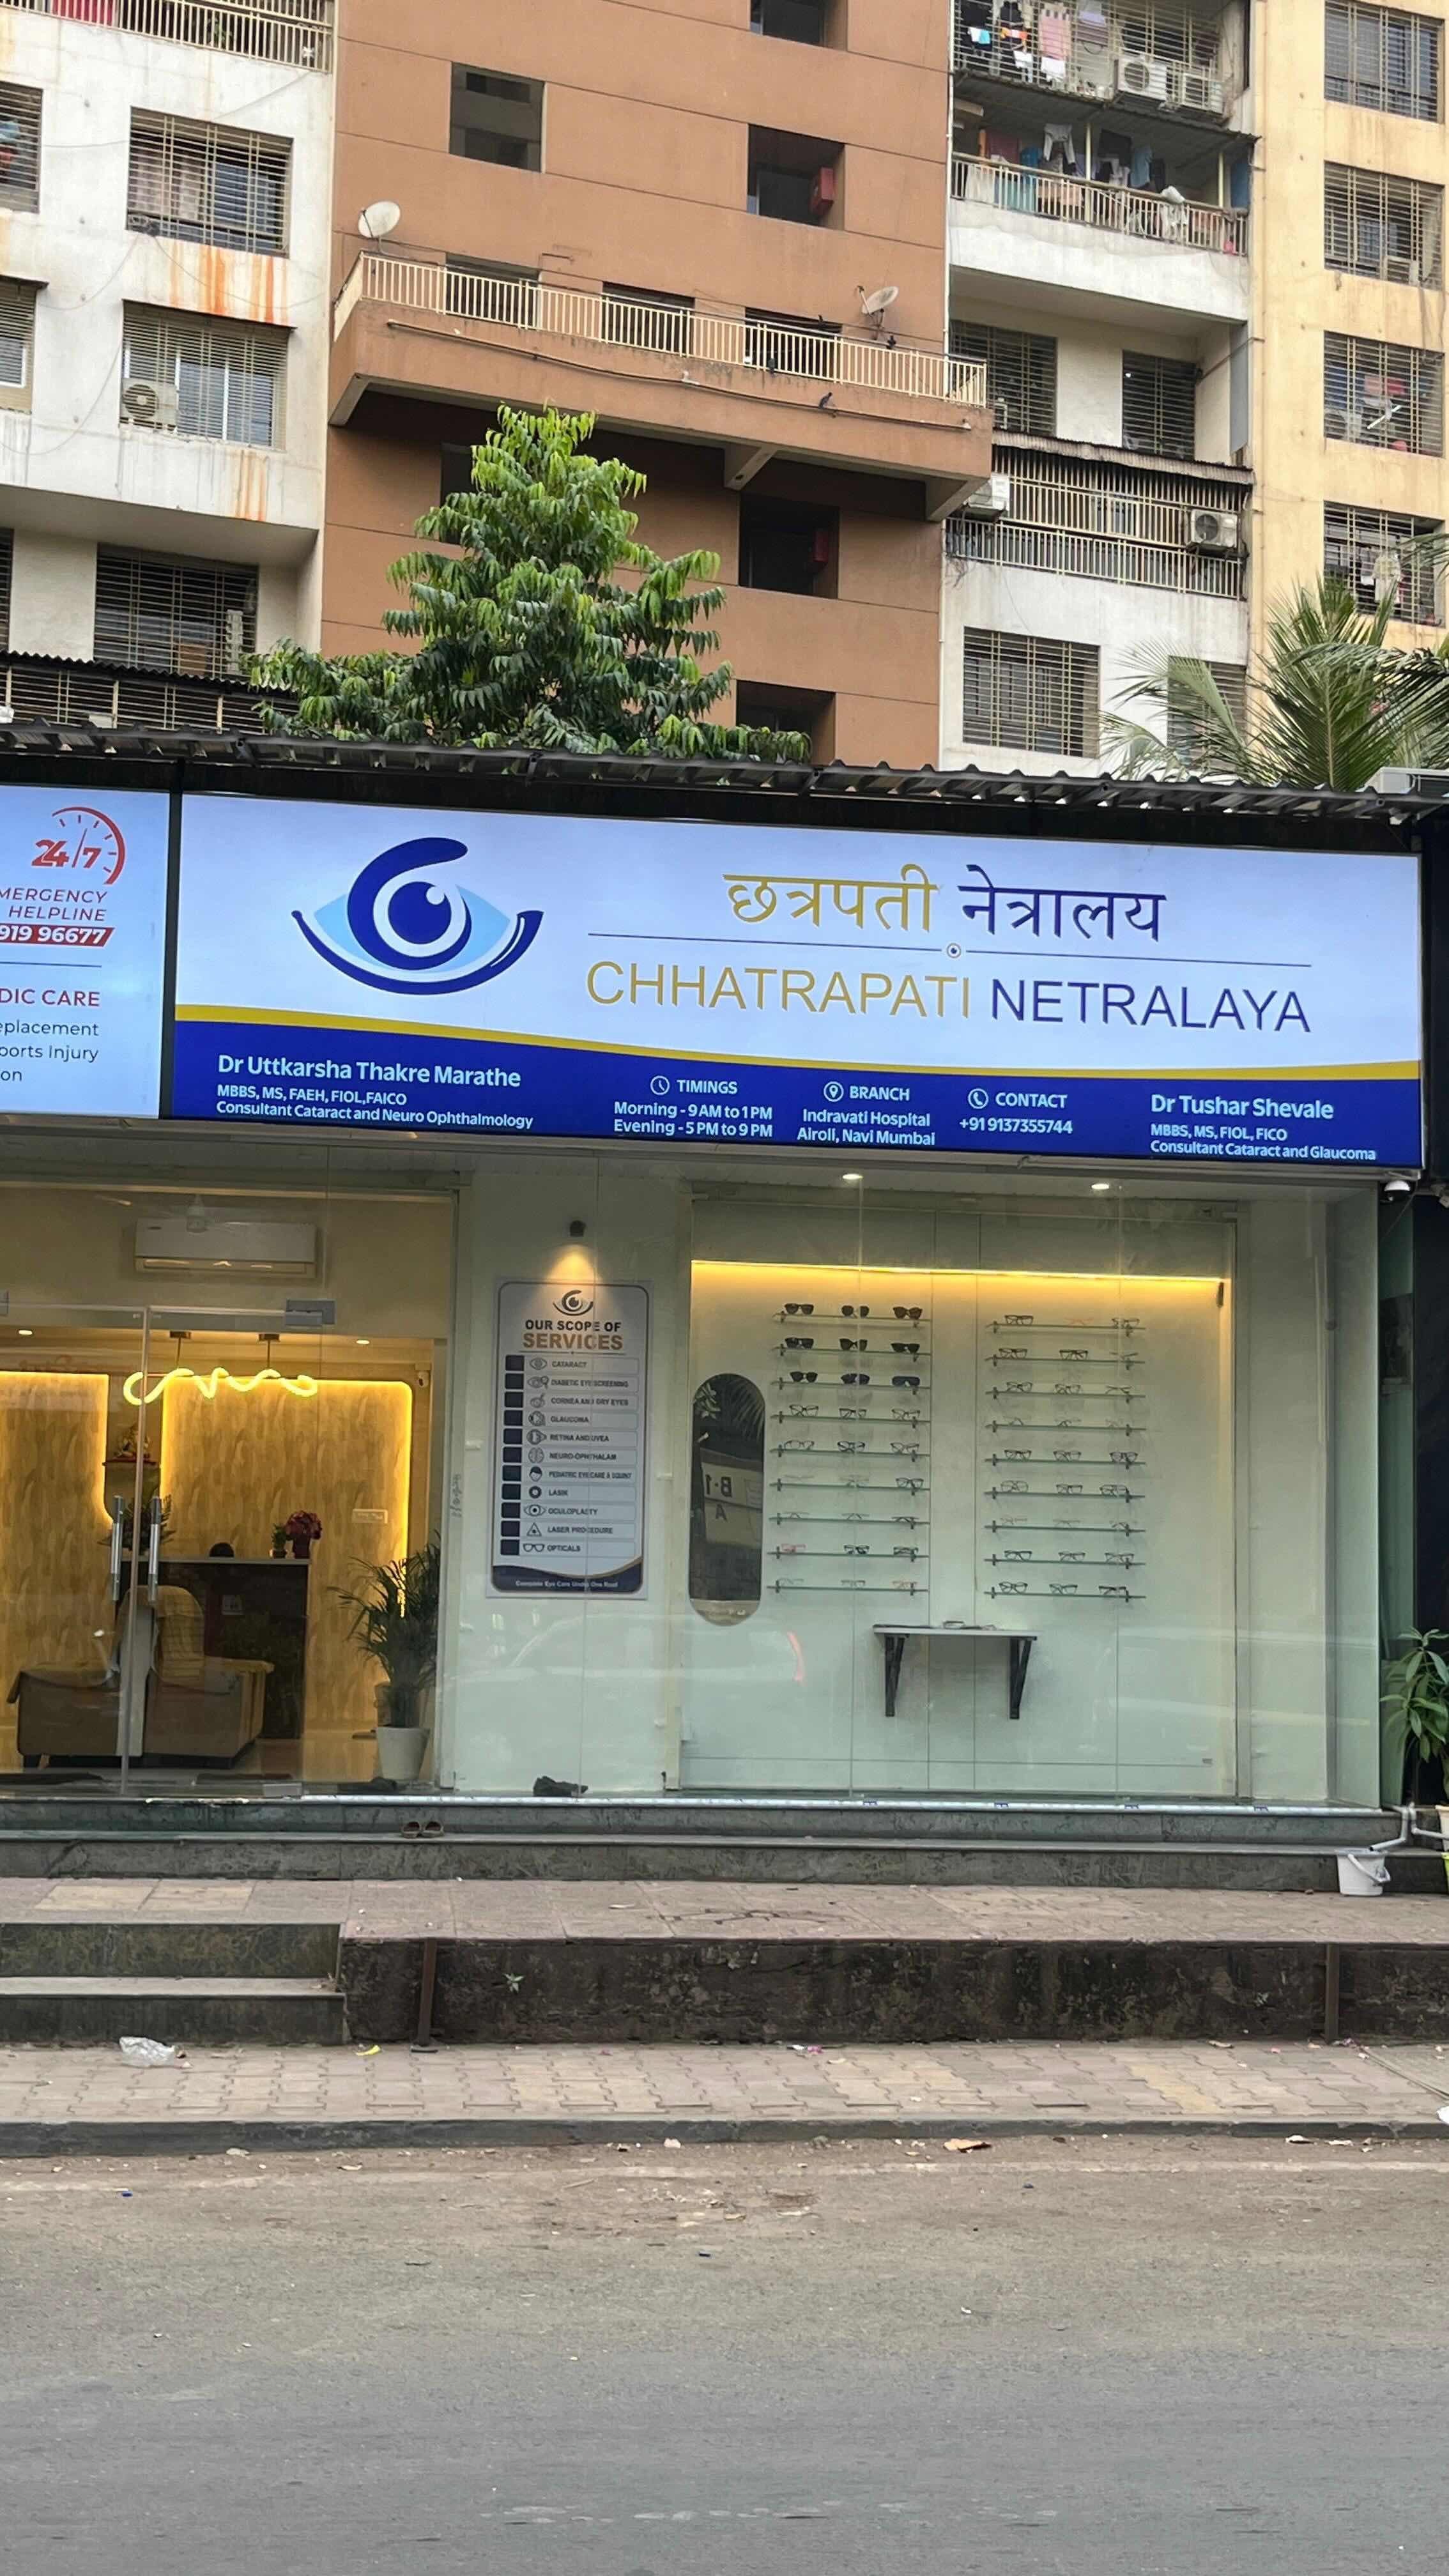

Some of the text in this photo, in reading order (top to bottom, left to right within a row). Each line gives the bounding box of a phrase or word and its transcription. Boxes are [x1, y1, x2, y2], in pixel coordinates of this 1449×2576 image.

[31, 829, 102, 868] 24/7
[723, 864, 1167, 942] छत्रपती नेत्रालय
[8, 905, 107, 921] HELPLINE
[38, 926, 106, 944] 96677
[42, 990, 100, 1007] CARE
[586, 960, 1312, 1033] CHHATRAPATI NETRALAYA
[49, 1045, 98, 1063] Injury
[0, 1071, 23, 1081] on
[218, 1054, 521, 1087] Dr Uttkarsha Thakre Marathe
[217, 1084, 259, 1100] MBBS,
[262, 1087, 288, 1101] MS,
[289, 1088, 330, 1103] FAEH,
[677, 1080, 739, 1094] TIMINGS
[849, 1086, 910, 1101] BRANCH
[995, 1091, 1068, 1108] CONTACT
[1151, 1094, 1335, 1119] Dr Tushar Shevale
[217, 1101, 534, 1130] Consultant Cataract and Neuro Ophthalmology
[614, 1101, 678, 1118] Morning
[724, 1106, 740, 1119] to
[802, 1108, 930, 1128] Indravati Hospital
[614, 1119, 676, 1136] Evening
[721, 1123, 737, 1136] to
[739, 1123, 748, 1136] 9
[751, 1123, 772, 1137] PM
[797, 1127, 935, 1146] Airoli, Navi Mumbai
[1150, 1123, 1287, 1141] MBBS, MS, FIOL, FICO
[1150, 1140, 1376, 1161] Consultant Cataract and Glaucoma
[525, 1319, 621, 1331] OUR SCOPE OF
[522, 1333, 622, 1349] SERVICES
